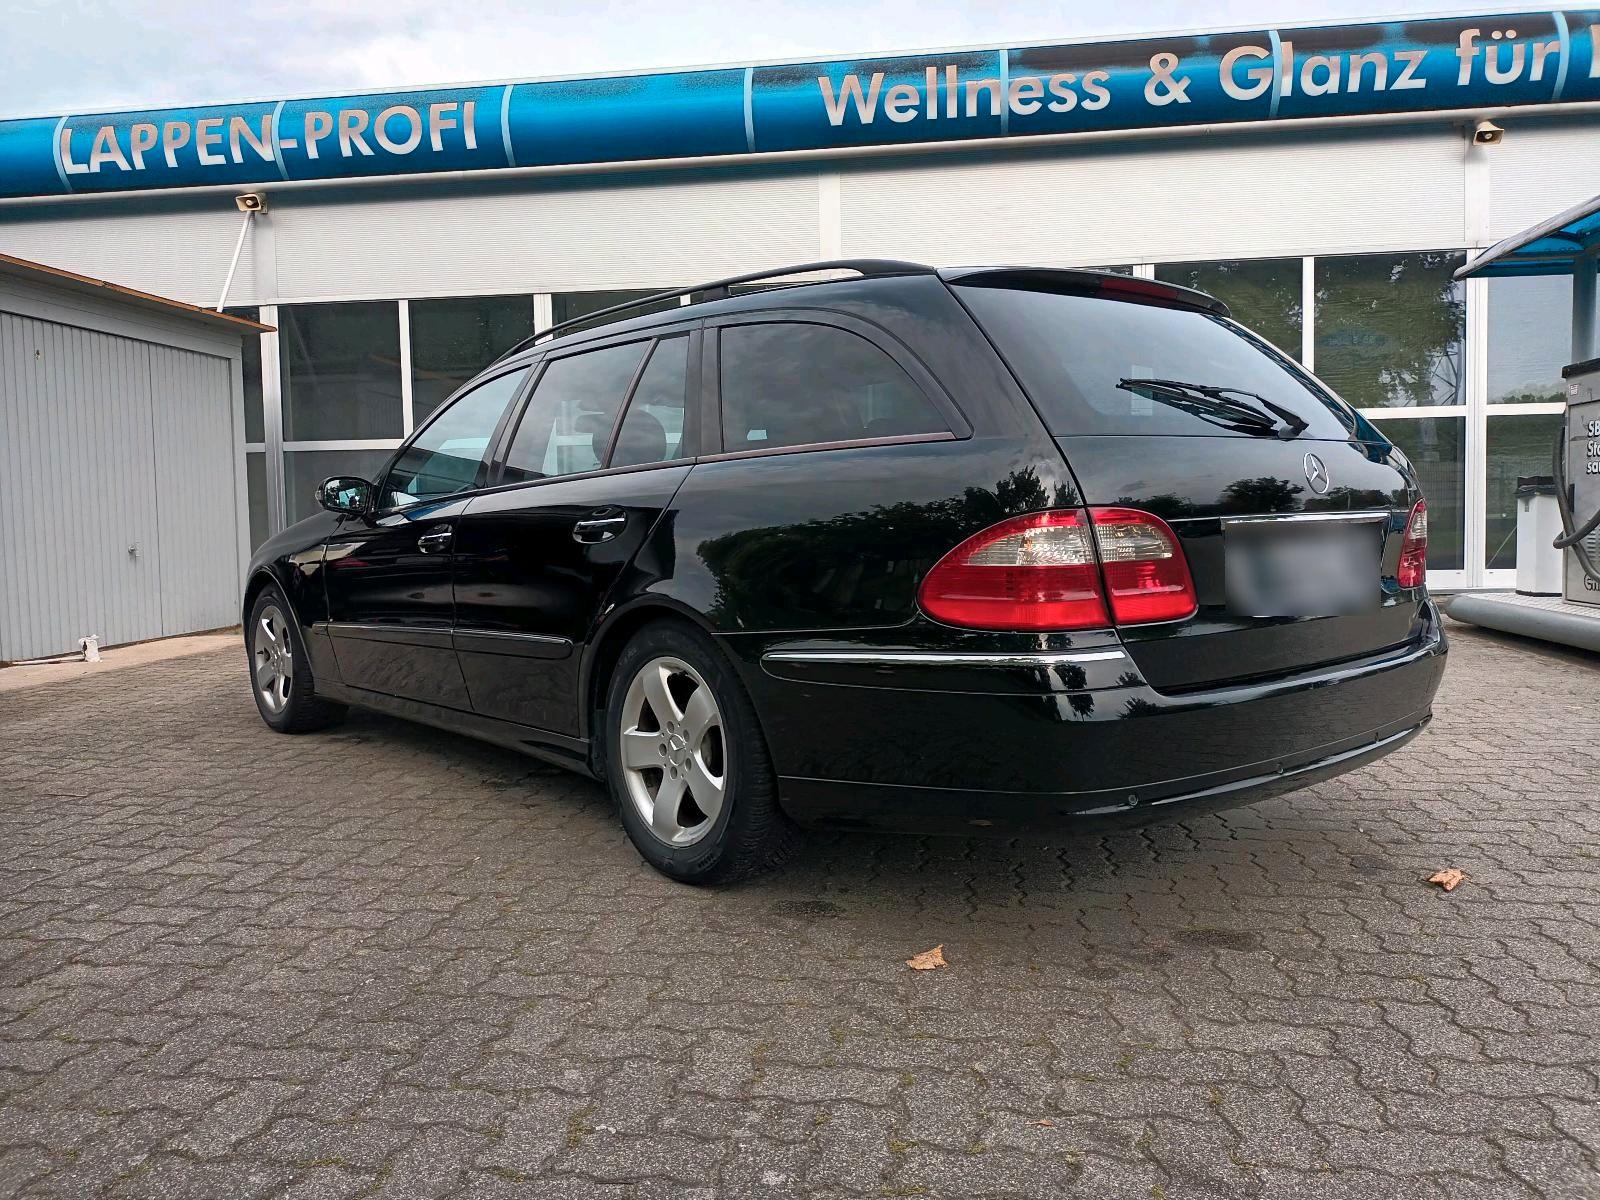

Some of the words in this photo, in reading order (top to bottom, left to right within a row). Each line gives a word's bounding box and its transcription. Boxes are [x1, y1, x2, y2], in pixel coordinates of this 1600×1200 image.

[817, 64, 1111, 126] Wellness
[1143, 52, 1192, 107] &
[1219, 41, 1429, 101] Glanz
[1455, 28, 1561, 86] für
[60, 101, 478, 175] LAPPEN-PROFI
[1586, 461, 1600, 474] sa
